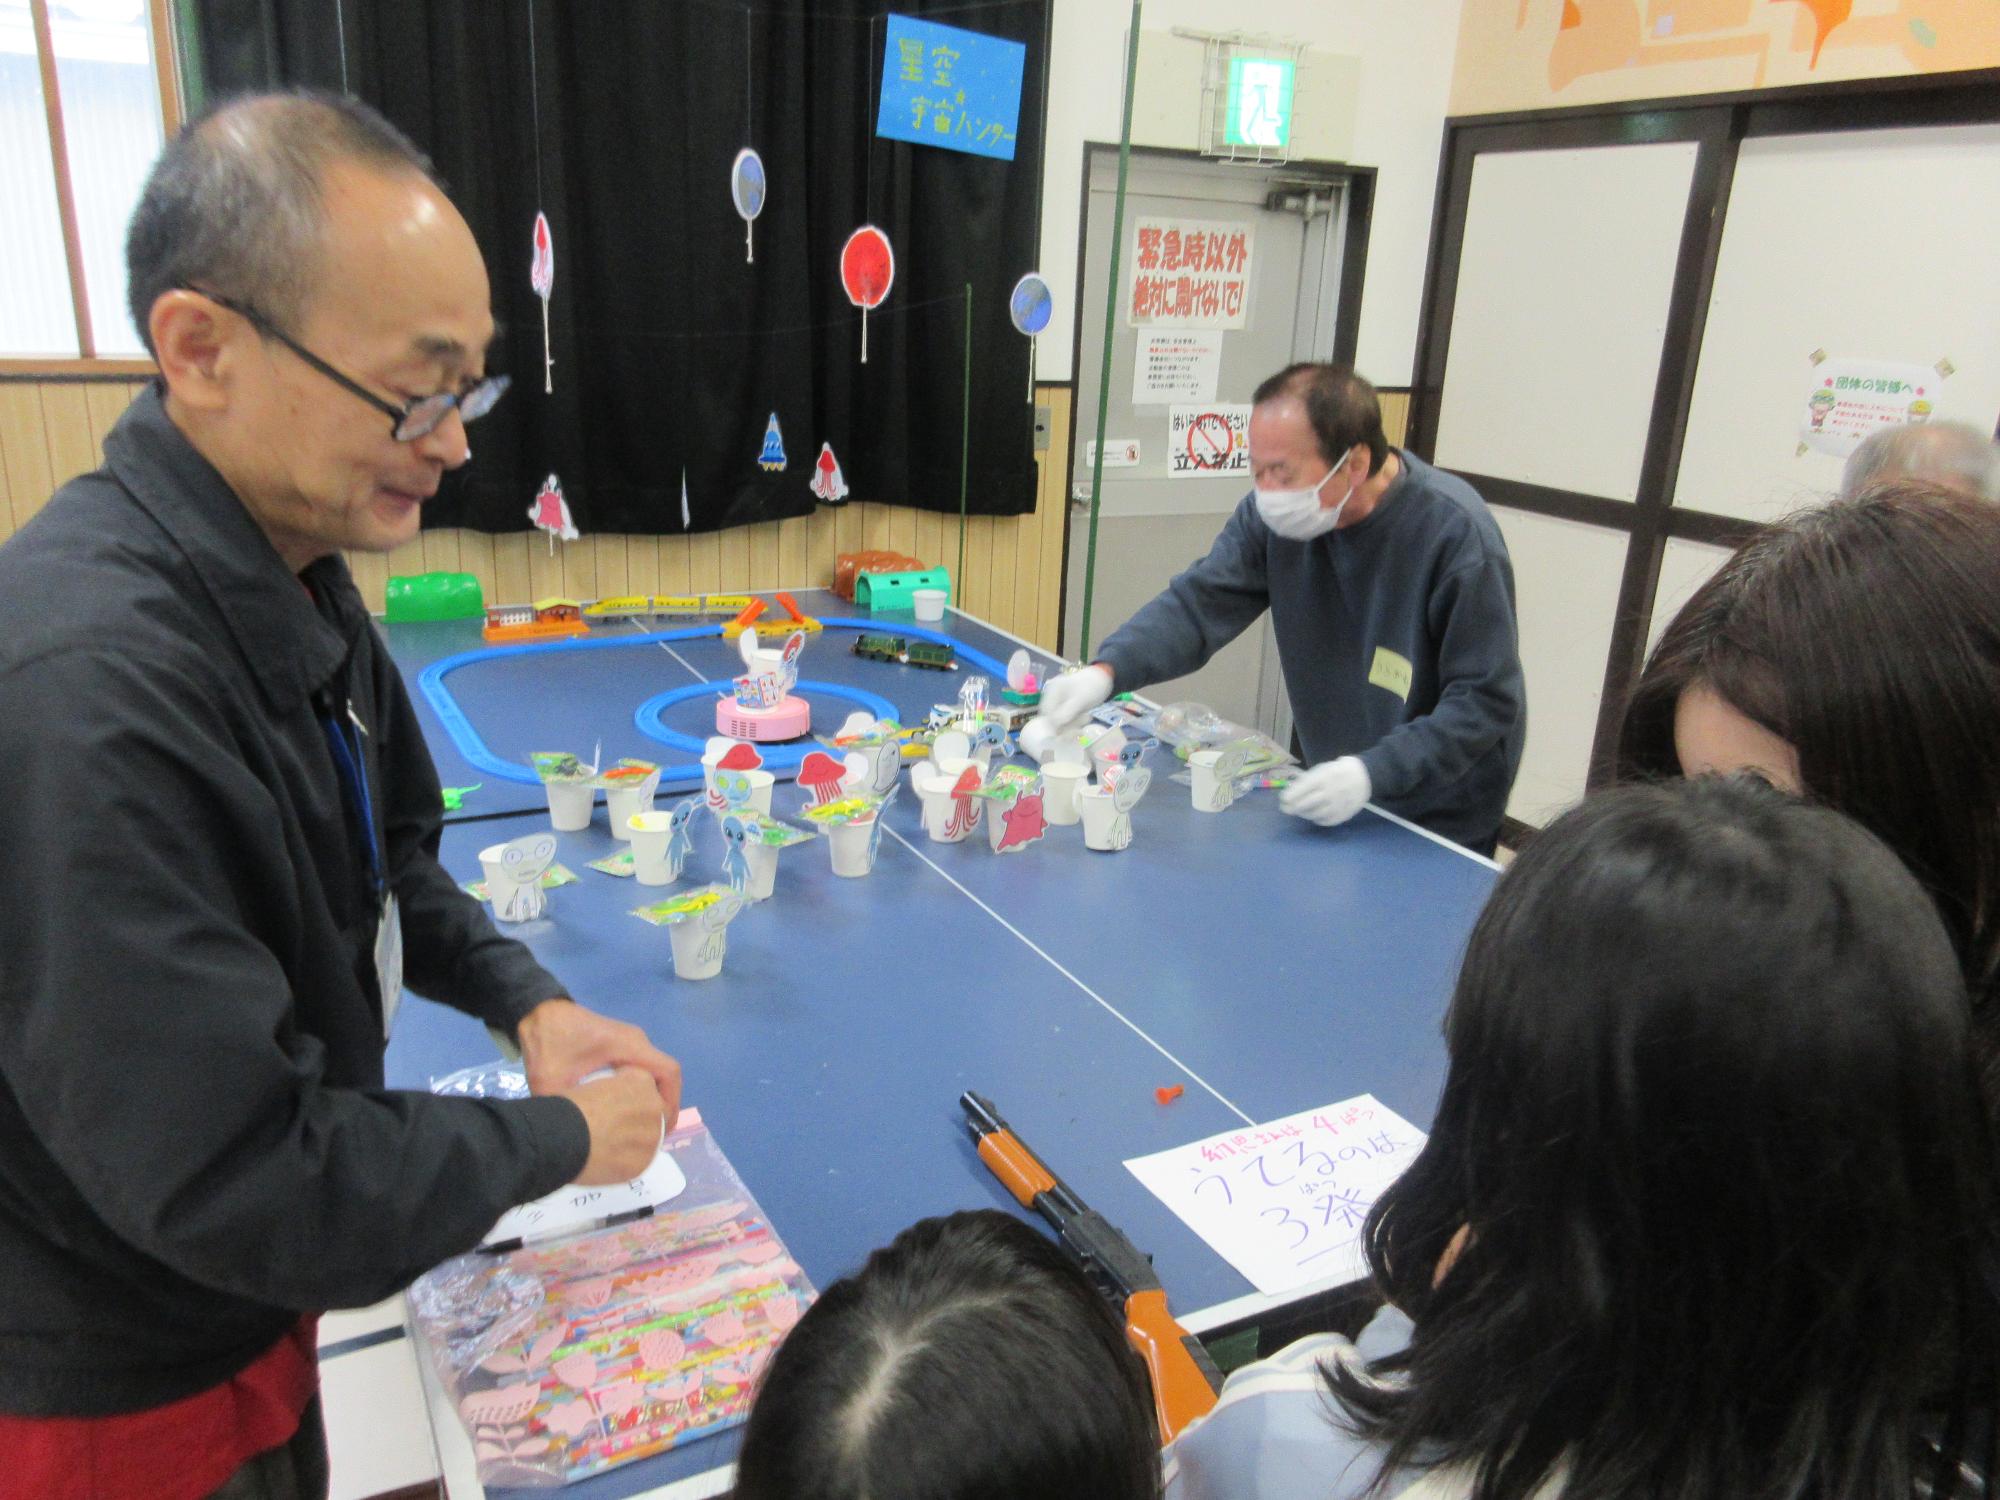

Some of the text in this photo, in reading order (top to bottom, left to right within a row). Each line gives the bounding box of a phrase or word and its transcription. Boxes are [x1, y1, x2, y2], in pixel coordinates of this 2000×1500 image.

[899, 37, 961, 88] 星空
[1138, 227, 1248, 274] 緊急時以外
[1172, 412, 1249, 431] はいらないでください
[1173, 451, 1248, 471] 立入禁止
[1190, 1129, 1408, 1205] うてるのは
